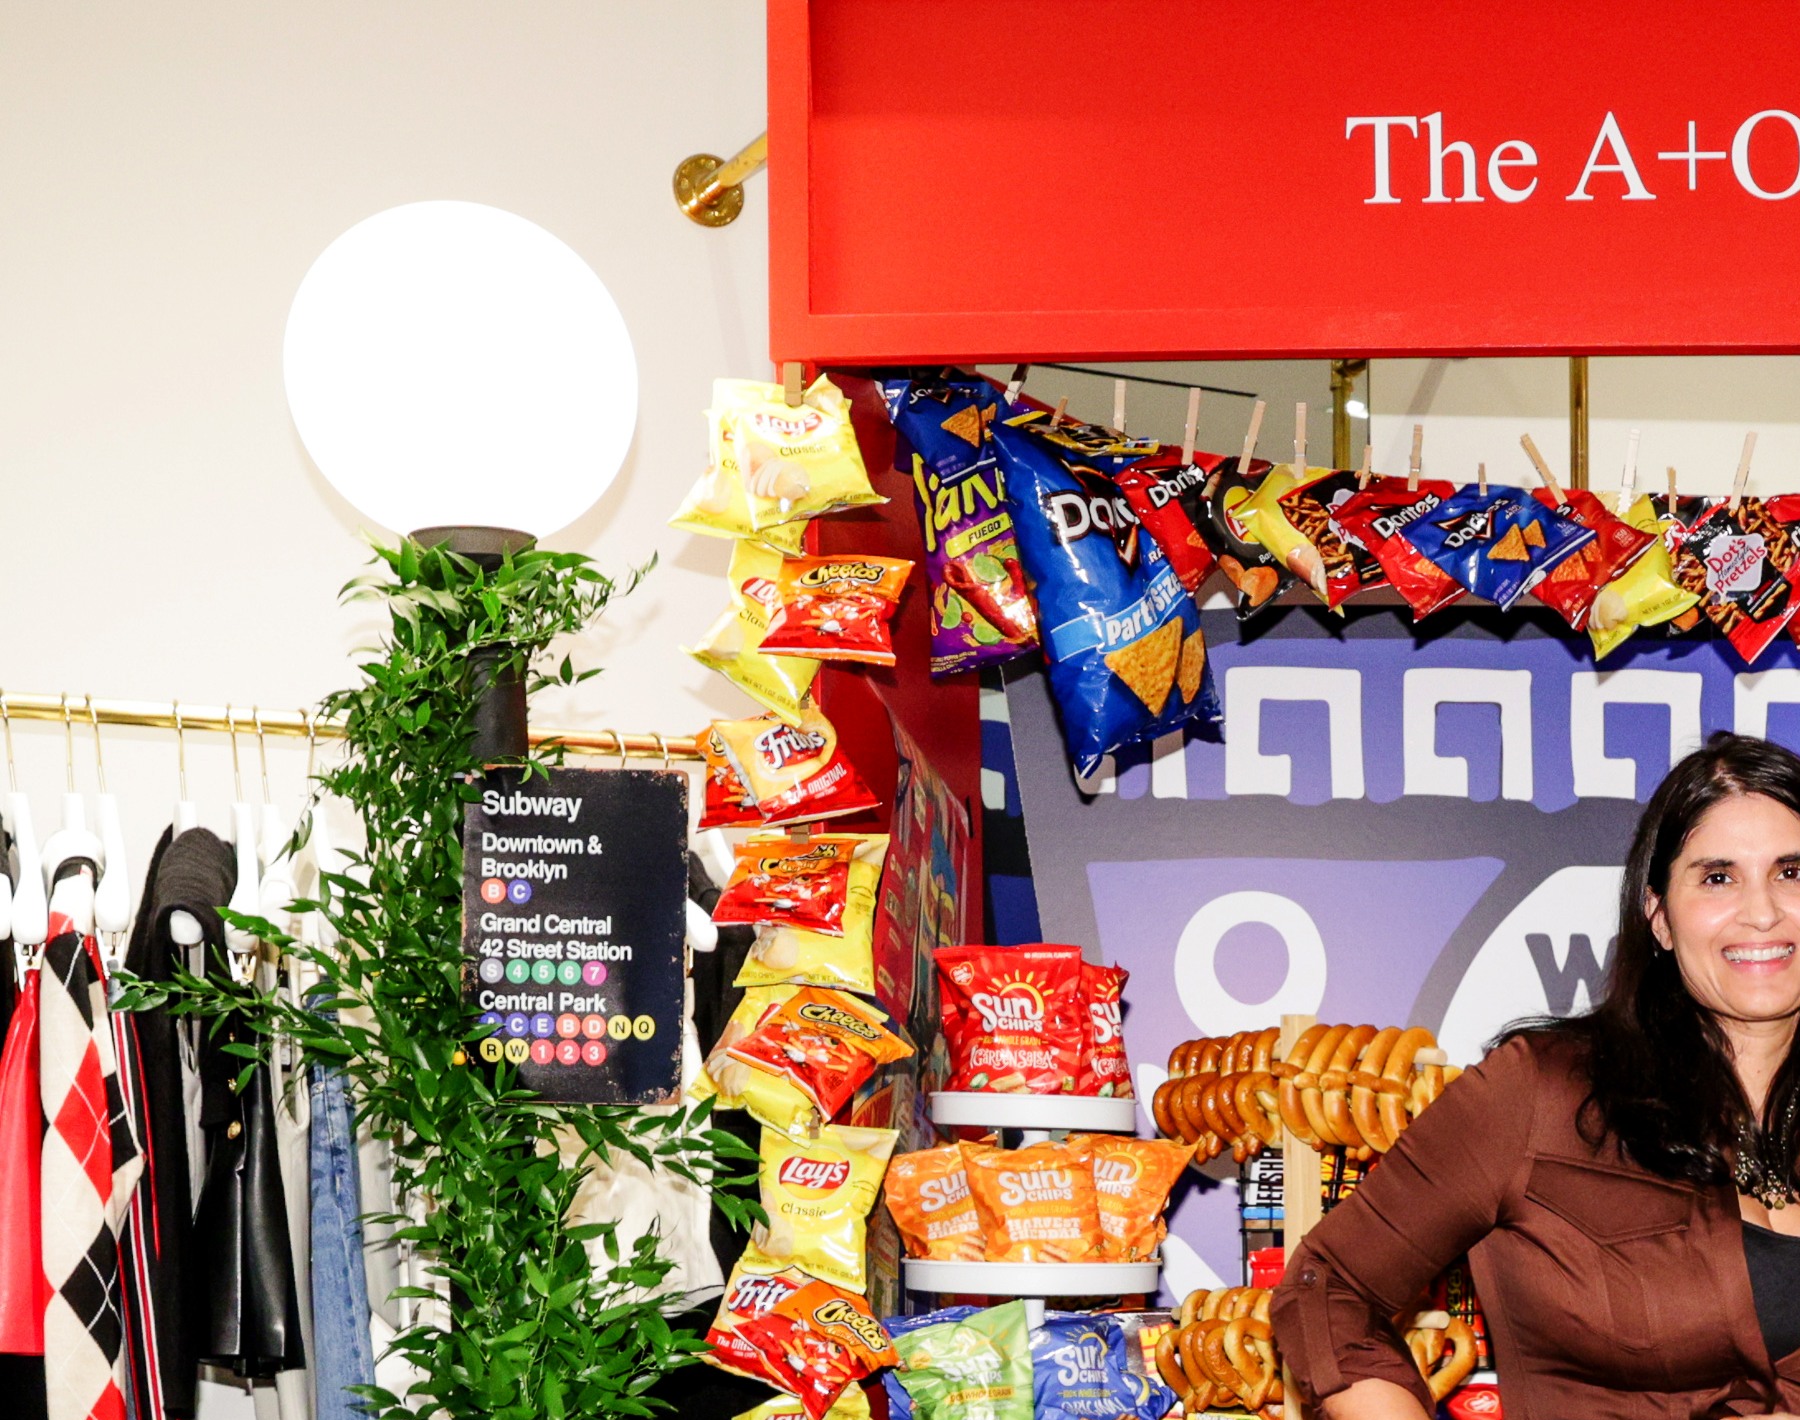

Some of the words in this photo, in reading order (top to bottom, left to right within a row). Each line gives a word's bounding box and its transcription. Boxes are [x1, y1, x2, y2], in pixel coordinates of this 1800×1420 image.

[1344, 110, 1539, 204] The
[967, 519, 1003, 545] FUEGO
[1372, 493, 1441, 540] Doritos
[1706, 536, 1748, 575] Dot's
[1713, 544, 1768, 596] Pretzels
[800, 561, 888, 590] Cheetos
[752, 722, 826, 776] Fritos
[807, 761, 848, 795] ORIGINAL
[480, 790, 582, 823] Subway
[481, 832, 584, 855] Downtown
[586, 835, 603, 855] &
[480, 857, 568, 883] Brooklyn
[479, 912, 541, 935] Grand
[543, 914, 612, 936] Central
[479, 939, 503, 958] 42
[506, 939, 562, 961] Street
[566, 940, 632, 962] Station
[479, 991, 553, 1012] Central
[559, 992, 607, 1013] Park
[971, 992, 1045, 1033] Sun
[799, 1000, 883, 1041] Cheetos
[996, 1018, 1045, 1032] CHIPS
[779, 1154, 849, 1190] Lay's
[997, 1169, 1073, 1206] Sun
[780, 1202, 829, 1218] Classic
[1026, 1185, 1073, 1202] CHIPS
[1005, 1216, 1082, 1231] HARVEST
[1009, 1227, 1083, 1242] CHEDDAR
[811, 1298, 889, 1352] Cheetos
[1054, 1344, 1108, 1387] Sun
